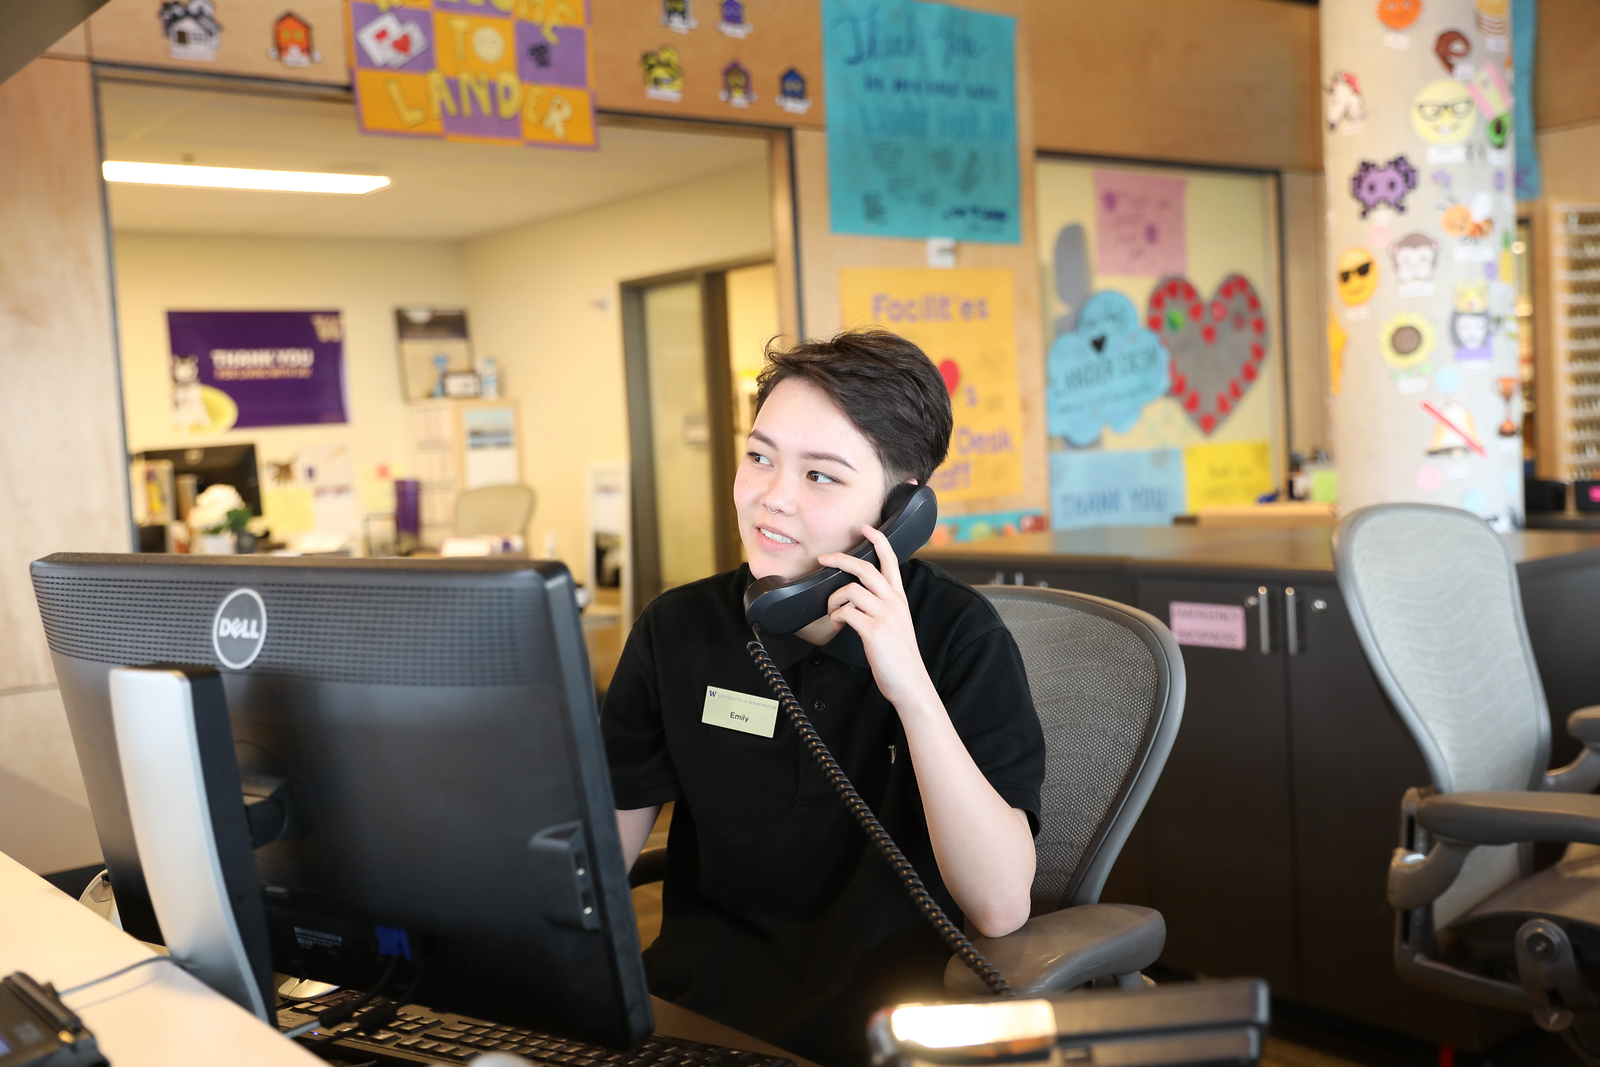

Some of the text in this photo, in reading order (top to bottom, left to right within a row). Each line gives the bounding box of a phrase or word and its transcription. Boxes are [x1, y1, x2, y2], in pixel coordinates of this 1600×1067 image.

[384, 69, 573, 142] LANDER
[210, 347, 315, 369] THANK YOU
[955, 426, 1016, 455] Desk
[928, 461, 972, 492] aff
[1060, 485, 1167, 518] THANK YOU
[219, 617, 260, 640] DELL
[718, 694, 742, 703] UNIVERSITY
[748, 701, 777, 710] WASHINGTON
[730, 712, 750, 722] Emily
